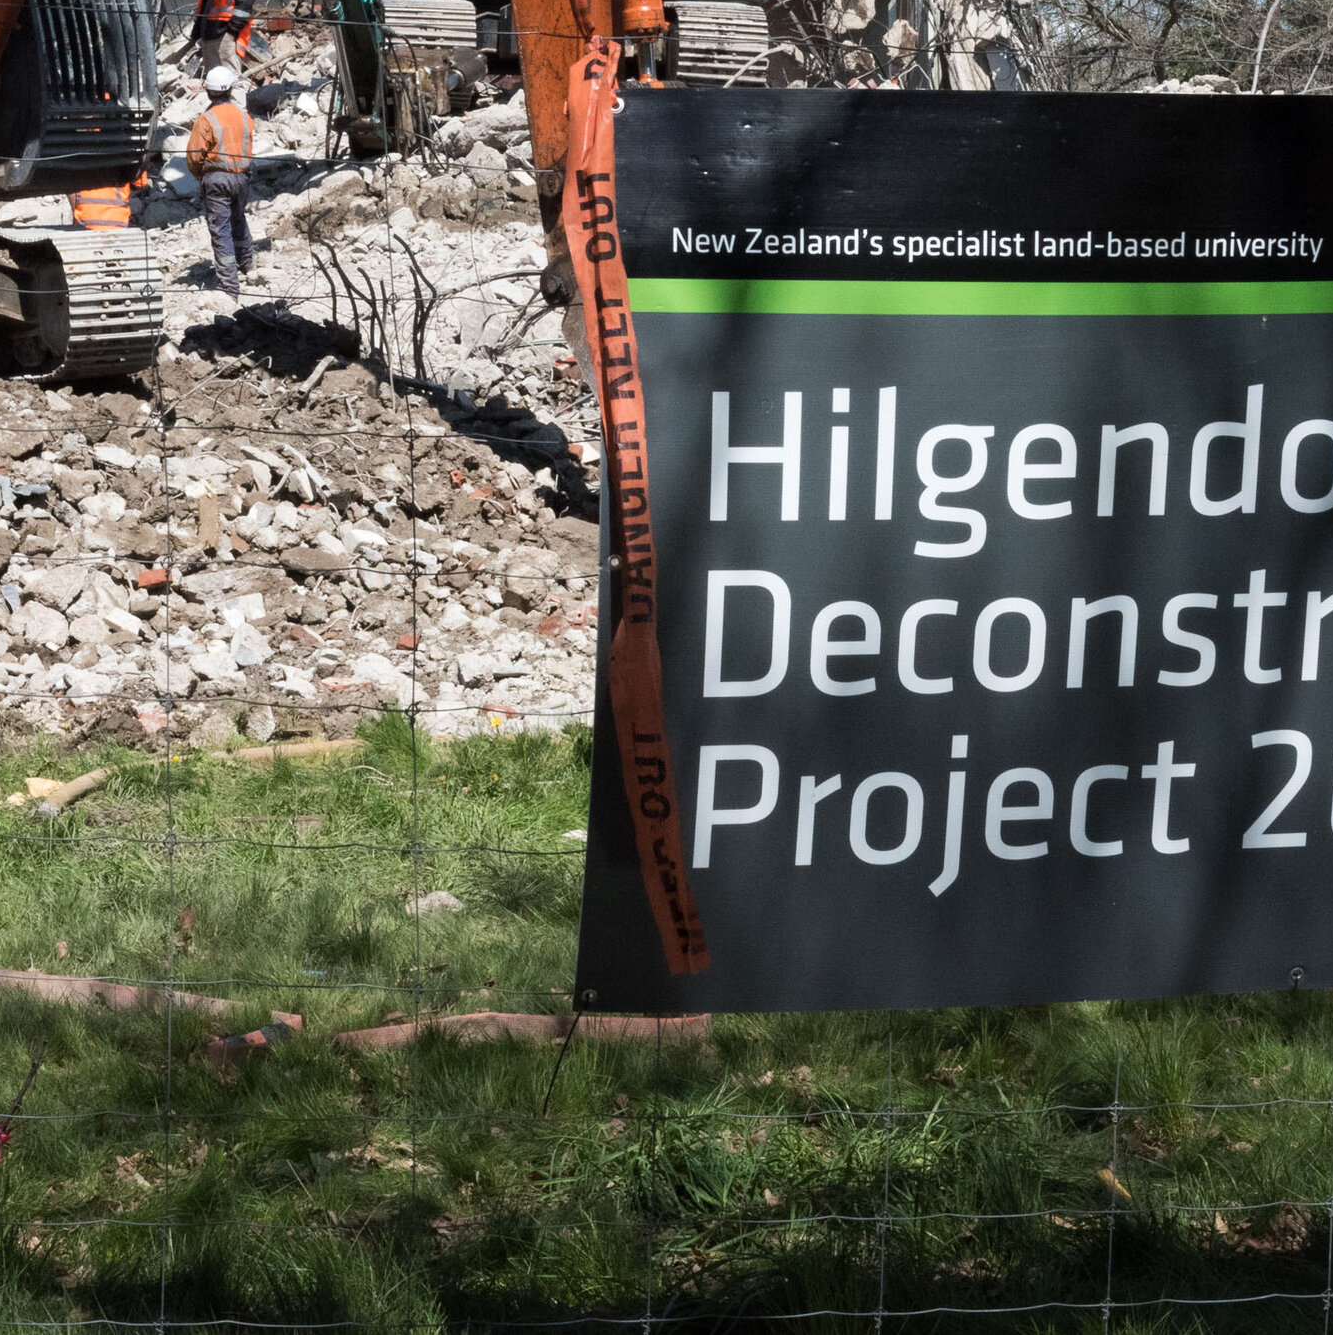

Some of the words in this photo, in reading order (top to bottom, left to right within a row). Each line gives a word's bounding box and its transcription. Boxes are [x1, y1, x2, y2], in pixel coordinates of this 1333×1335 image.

[576, 169, 617, 262] OUT
[672, 227, 736, 254] New
[745, 227, 884, 256] Zealand's
[892, 229, 1026, 263] specialist
[1034, 230, 1186, 258] land-based
[1195, 231, 1324, 263] university
[692, 734, 1197, 898] Project
